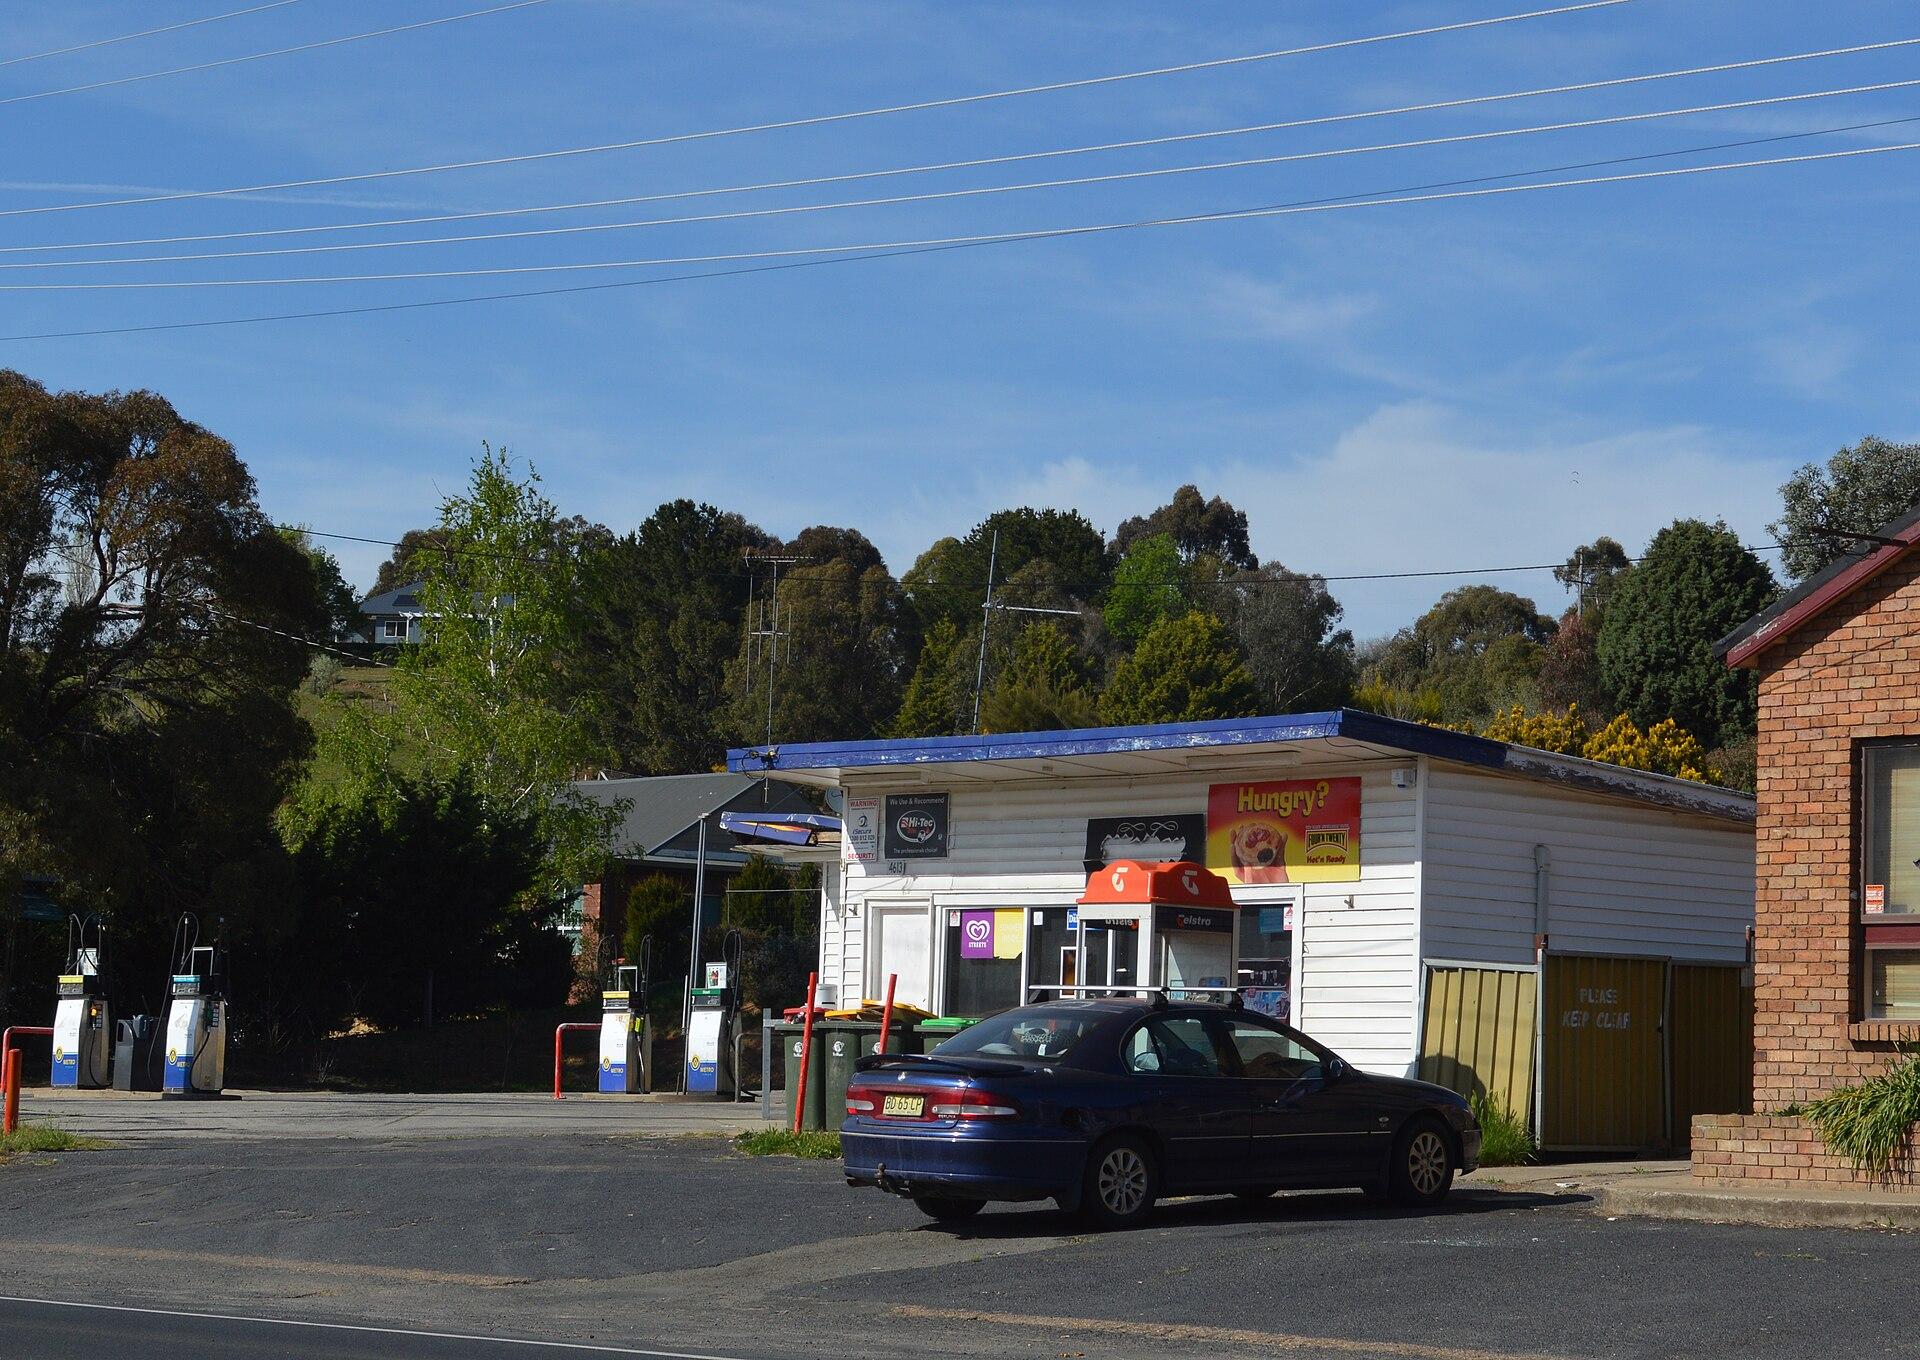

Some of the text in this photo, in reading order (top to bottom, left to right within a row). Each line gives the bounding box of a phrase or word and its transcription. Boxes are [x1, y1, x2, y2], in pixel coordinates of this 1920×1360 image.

[850, 799, 877, 808] WARNING
[899, 798, 908, 806] Use
[915, 796, 945, 805] Recommend
[1237, 782, 1329, 818] Hungry?
[1325, 832, 1345, 846] TWENTY
[848, 852, 874, 860] SECURITY
[1326, 854, 1346, 865] Ready
[889, 861, 904, 874] 4613
[885, 1097, 922, 1111] BD 65 CP
